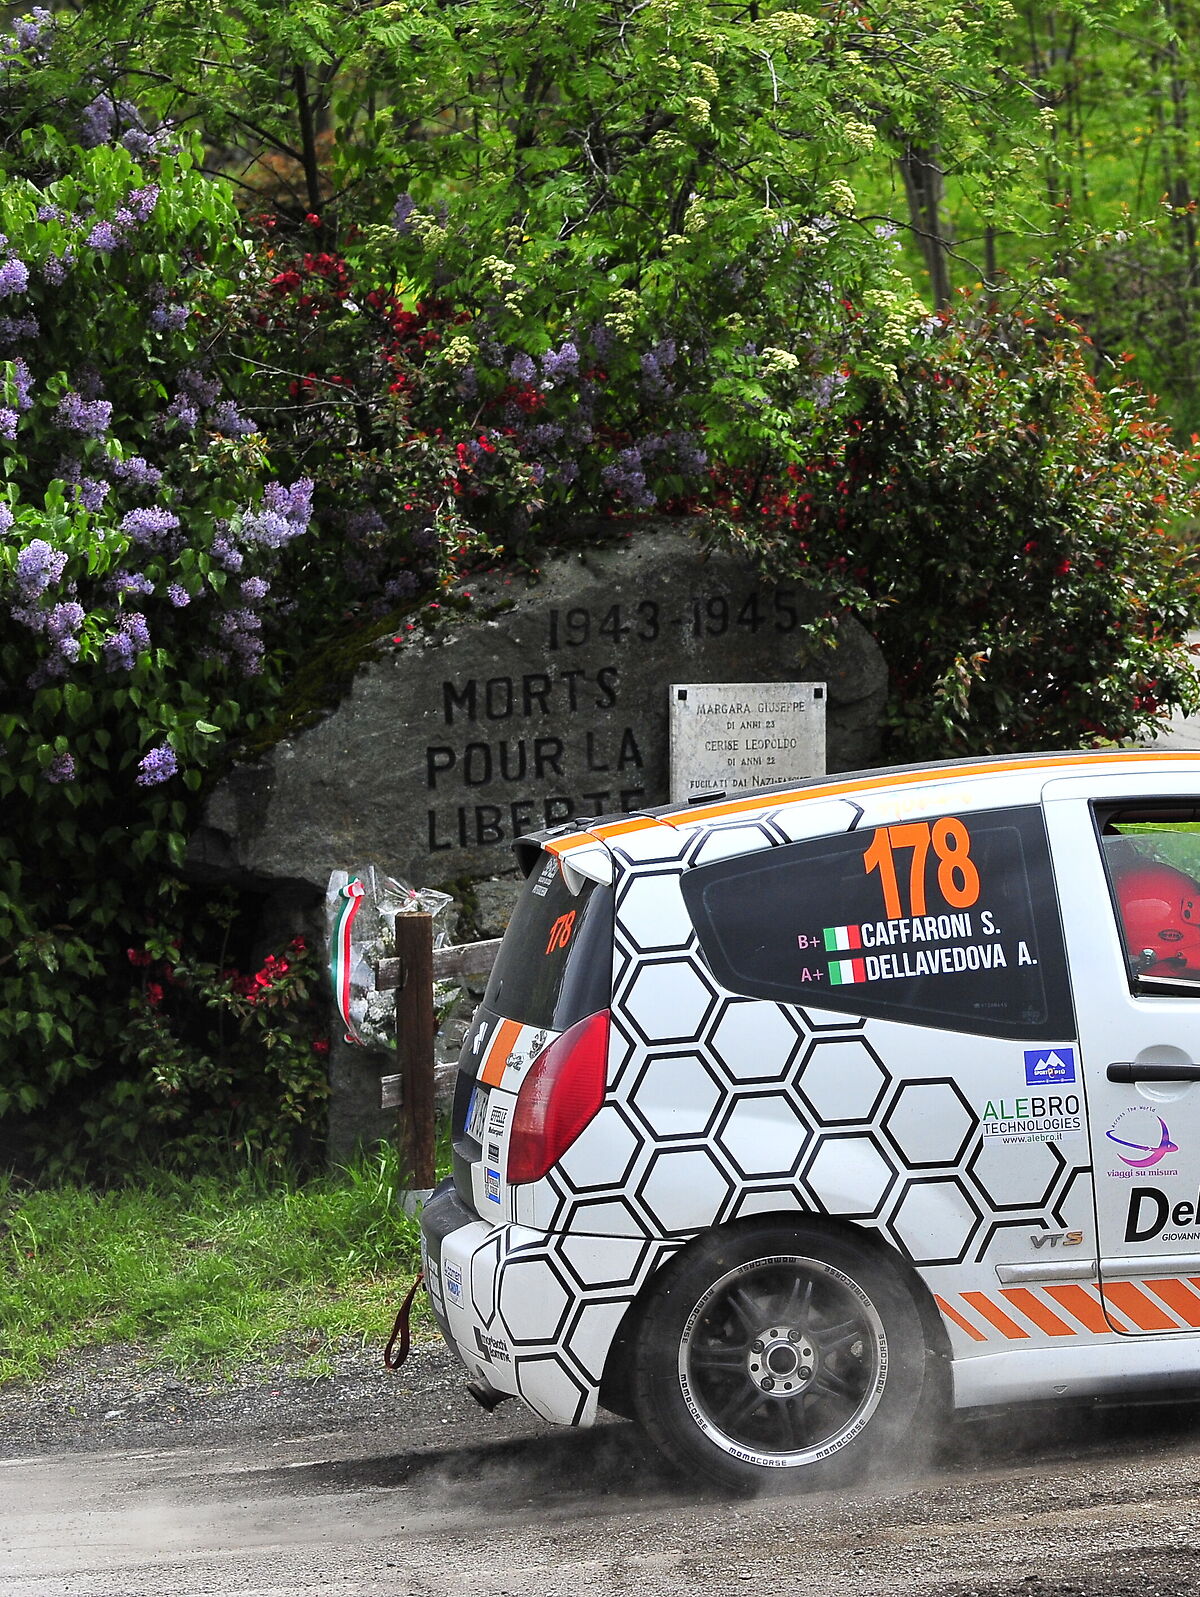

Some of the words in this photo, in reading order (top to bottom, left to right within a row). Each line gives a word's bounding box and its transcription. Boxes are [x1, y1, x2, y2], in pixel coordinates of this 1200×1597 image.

[443, 667, 618, 725] MORTS
[697, 704, 750, 715] MARGARA
[758, 702, 805, 713] GIUSEPPE
[727, 721, 735, 729] DI
[741, 721, 761, 729] ANNI
[765, 720, 775, 728] 23
[705, 740, 739, 751] CERISE
[746, 738, 797, 750] LEOPOLDO
[427, 737, 564, 788] POUR
[587, 727, 644, 771] LA
[728, 758, 736, 766] DI
[741, 757, 762, 766] ANNI
[767, 757, 776, 765] 22
[732, 778, 747, 788] DAI
[863, 817, 980, 919] 178
[545, 910, 576, 955] 178
[797, 935, 821, 950] B+
[861, 912, 972, 948] CAFFARONI
[981, 911, 1001, 936] S.
[801, 967, 824, 982] A+
[865, 943, 1007, 981] DELLAVEDOVA
[1018, 941, 1038, 967] A.
[983, 1095, 1079, 1120] ALEBRO
[983, 1117, 1080, 1134] TECHNOLOGIES
[1003, 1133, 1062, 1144] www.alebro.it
[1107, 1169, 1133, 1178] viaggi
[1148, 1169, 1178, 1177] misura
[1030, 1231, 1083, 1248] VTS
